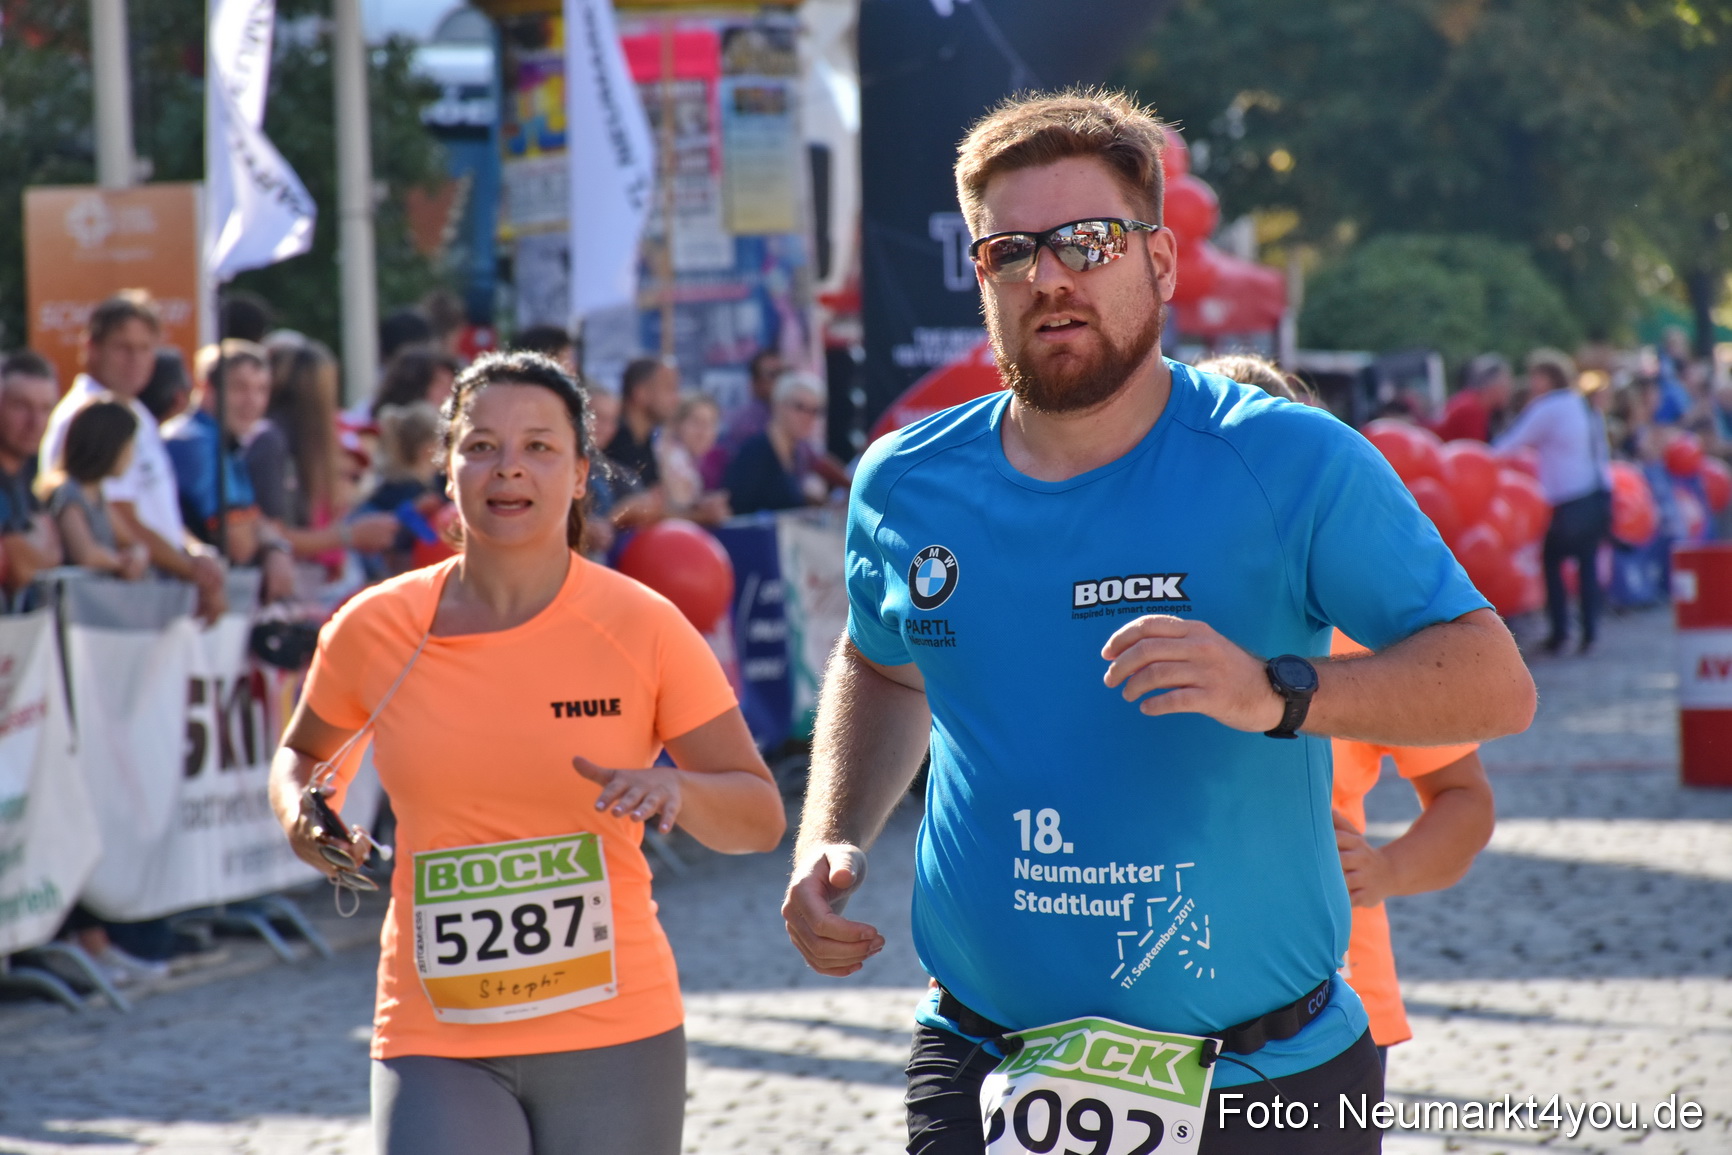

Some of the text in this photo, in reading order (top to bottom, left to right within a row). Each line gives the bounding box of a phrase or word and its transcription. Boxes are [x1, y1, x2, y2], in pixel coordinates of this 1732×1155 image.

[914, 548, 956, 569] BMW
[1074, 576, 1183, 606] BOCK
[1072, 603, 1193, 620] inspired by smart concepts
[906, 619, 955, 636] PARTL
[909, 634, 957, 648] Neumarkt
[550, 698, 622, 718] THULE
[1013, 808, 1074, 854] 18.
[427, 843, 583, 895] BOCK
[1014, 857, 1165, 884] Neumarkter
[1014, 889, 1135, 921] Stadtlauf
[435, 896, 584, 966] 5287
[1131, 922, 1178, 978] September
[1174, 898, 1196, 926] 2017
[1003, 1030, 1190, 1090] BOCK
